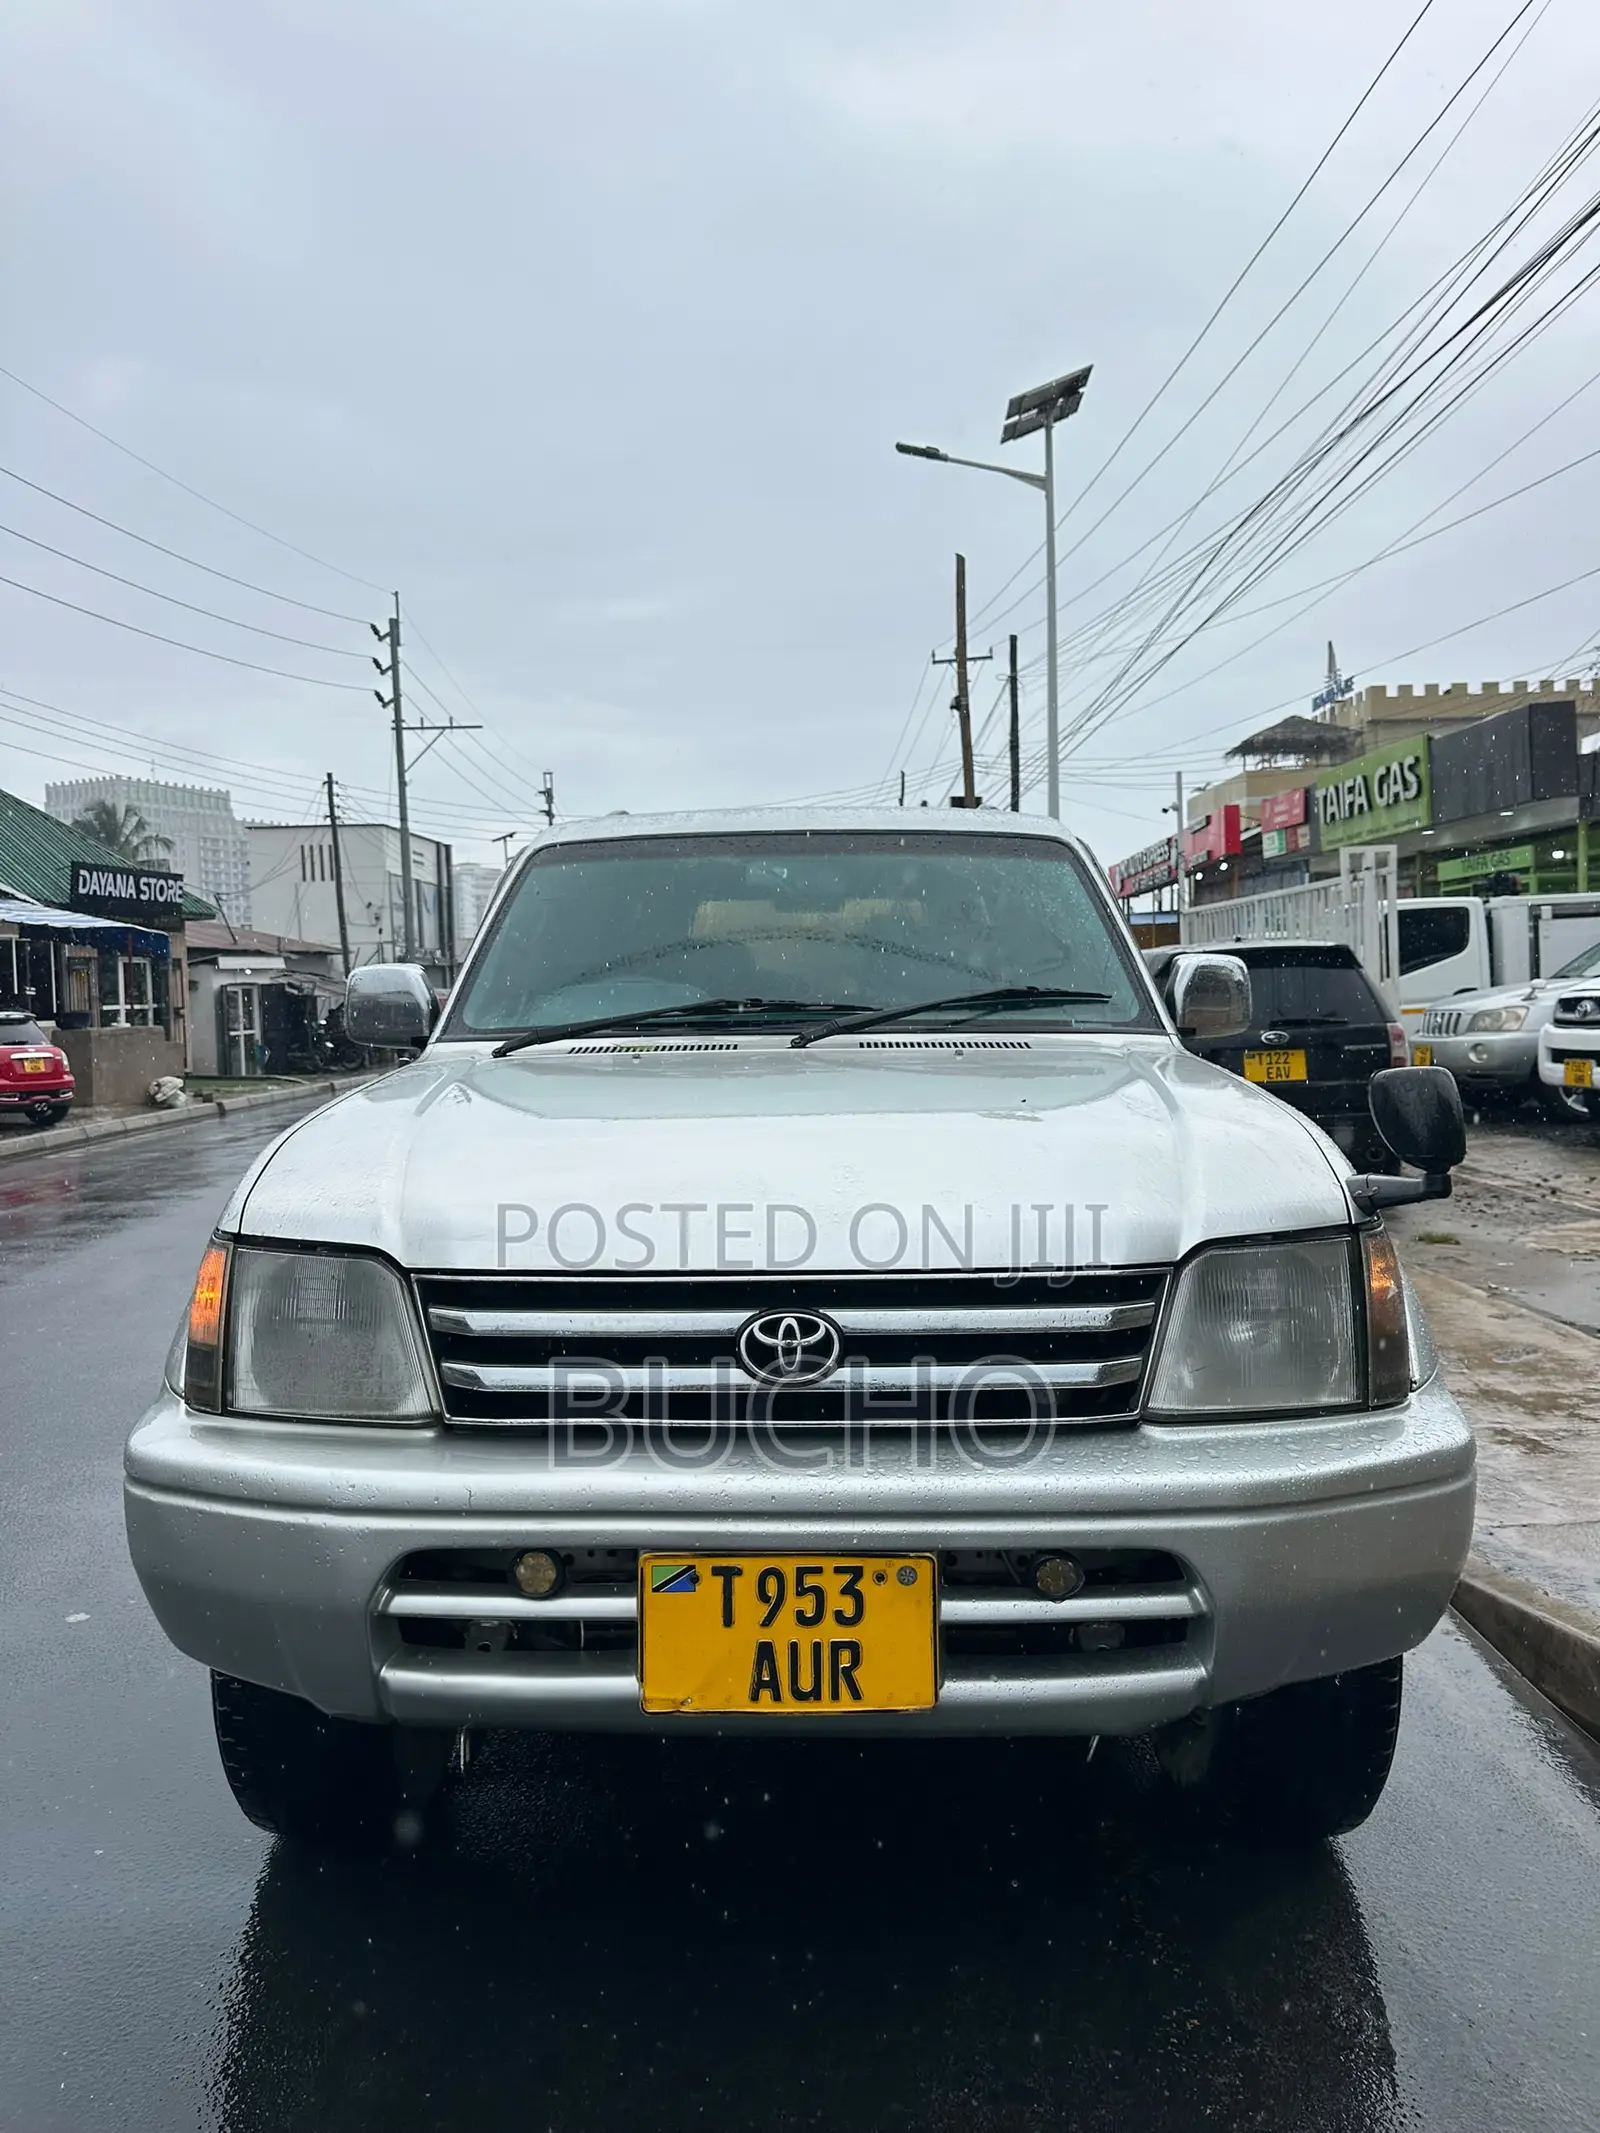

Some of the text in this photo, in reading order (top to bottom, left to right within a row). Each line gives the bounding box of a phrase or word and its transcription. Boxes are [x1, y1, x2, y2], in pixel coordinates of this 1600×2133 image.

[1315, 775, 1371, 825] TAIFA
[1374, 755, 1420, 808] GAS
[78, 869, 184, 903] DAYANA STORE
[1266, 1066, 1291, 1080] EAV
[749, 1638, 864, 1702] AUR
